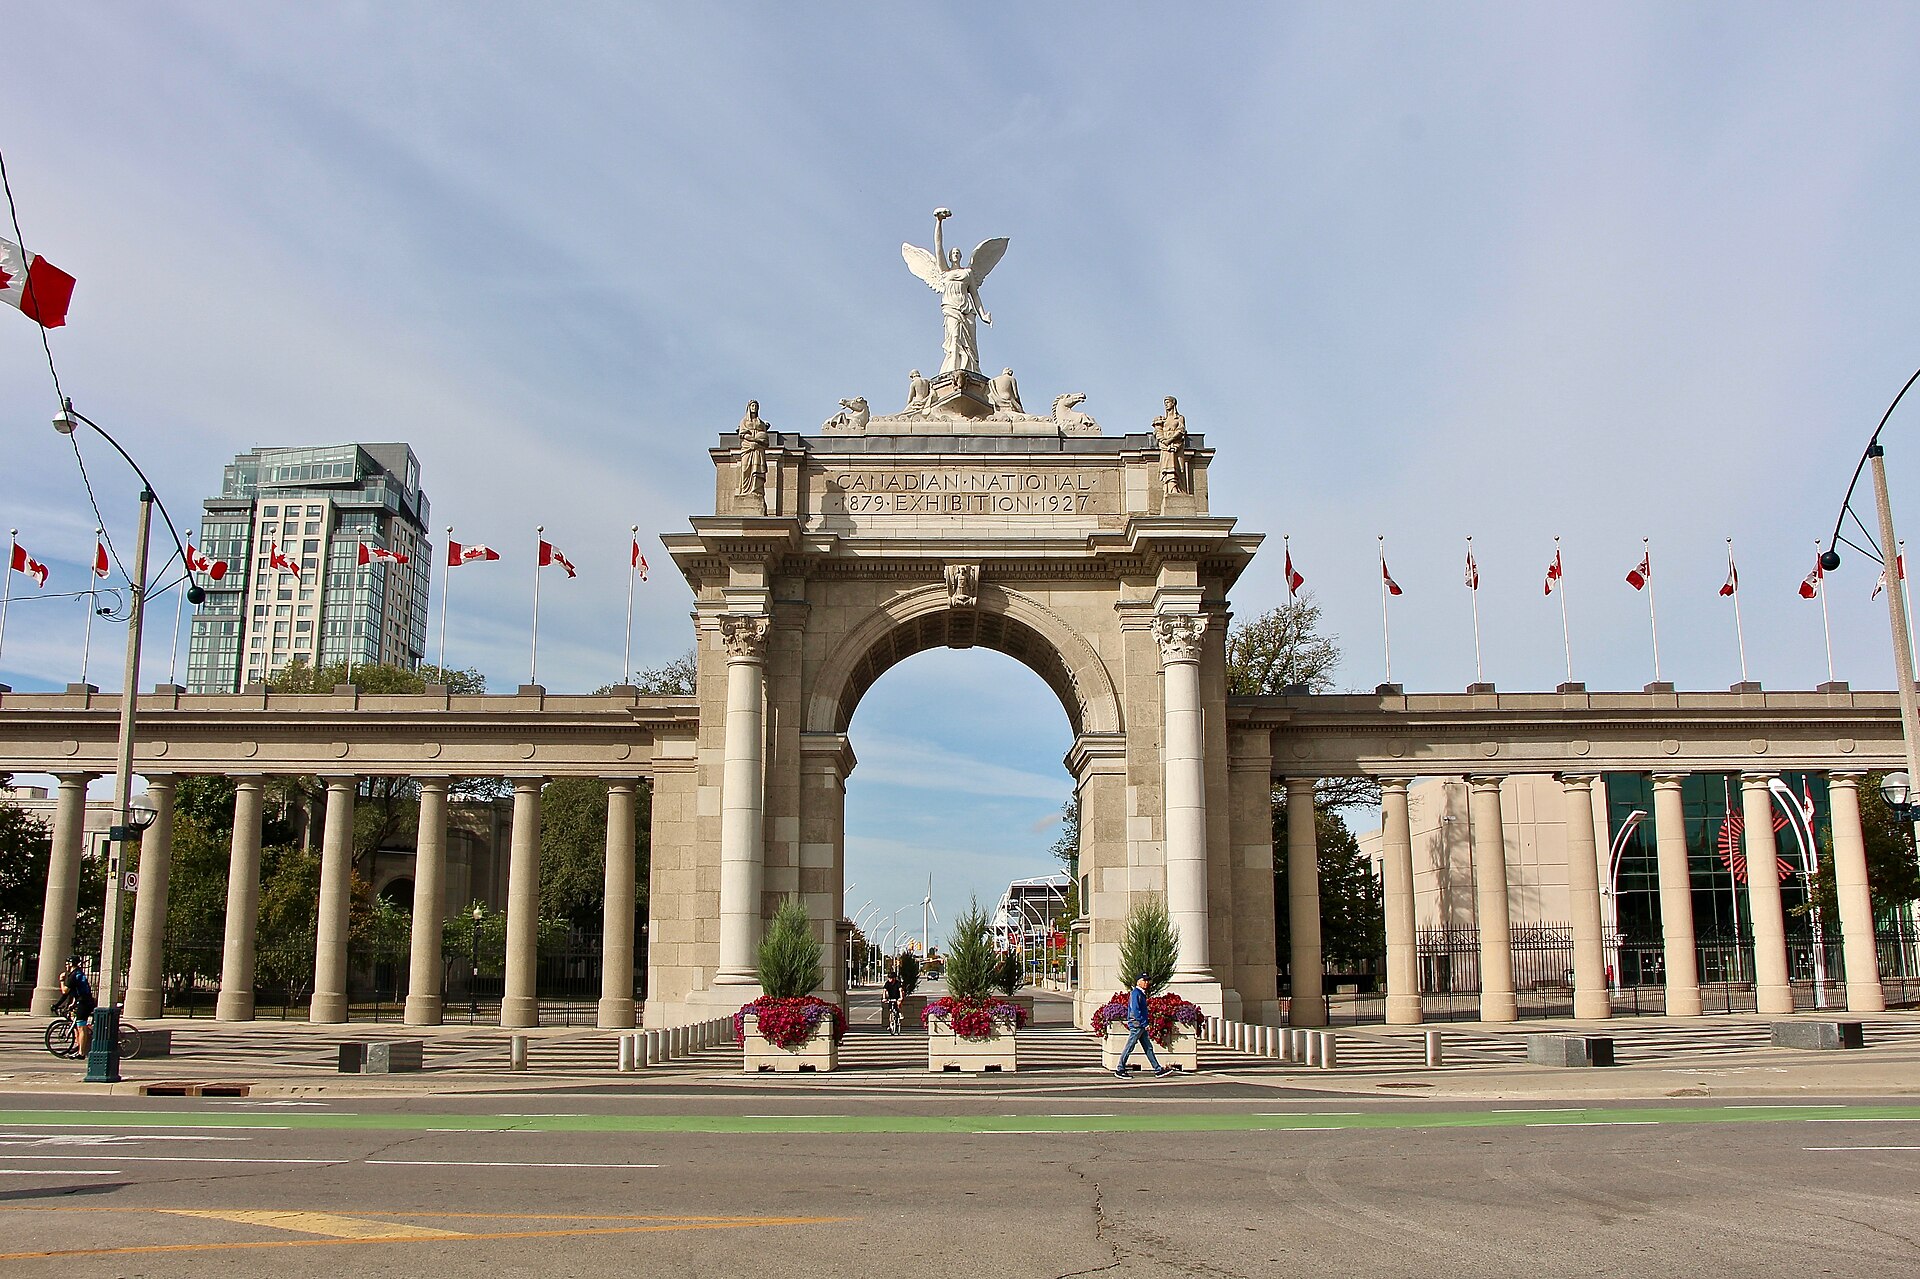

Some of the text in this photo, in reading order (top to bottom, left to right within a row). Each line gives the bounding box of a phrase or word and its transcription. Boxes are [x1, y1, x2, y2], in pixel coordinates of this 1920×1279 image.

[836, 474, 1091, 490] CANADIAN NATIONAL
[841, 495, 1089, 512] 1879 EXHIBITION 1927
